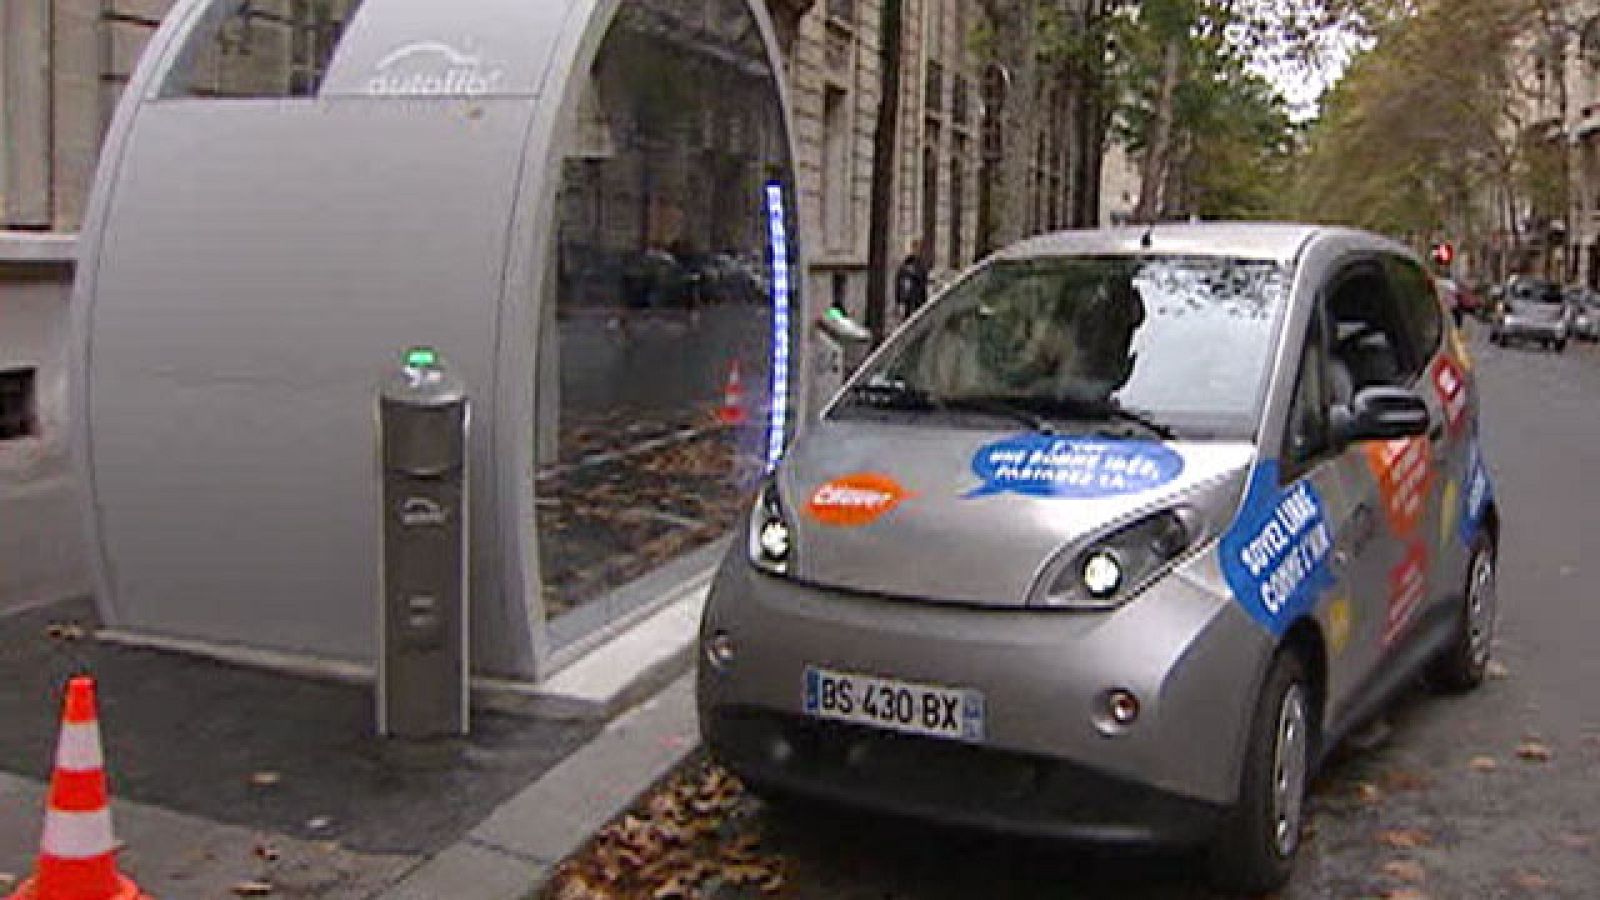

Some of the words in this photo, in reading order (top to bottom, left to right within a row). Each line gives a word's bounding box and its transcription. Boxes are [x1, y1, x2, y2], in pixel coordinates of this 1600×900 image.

[822, 678, 854, 714] BS
[862, 684, 914, 724] 430
[922, 693, 959, 730] BX
